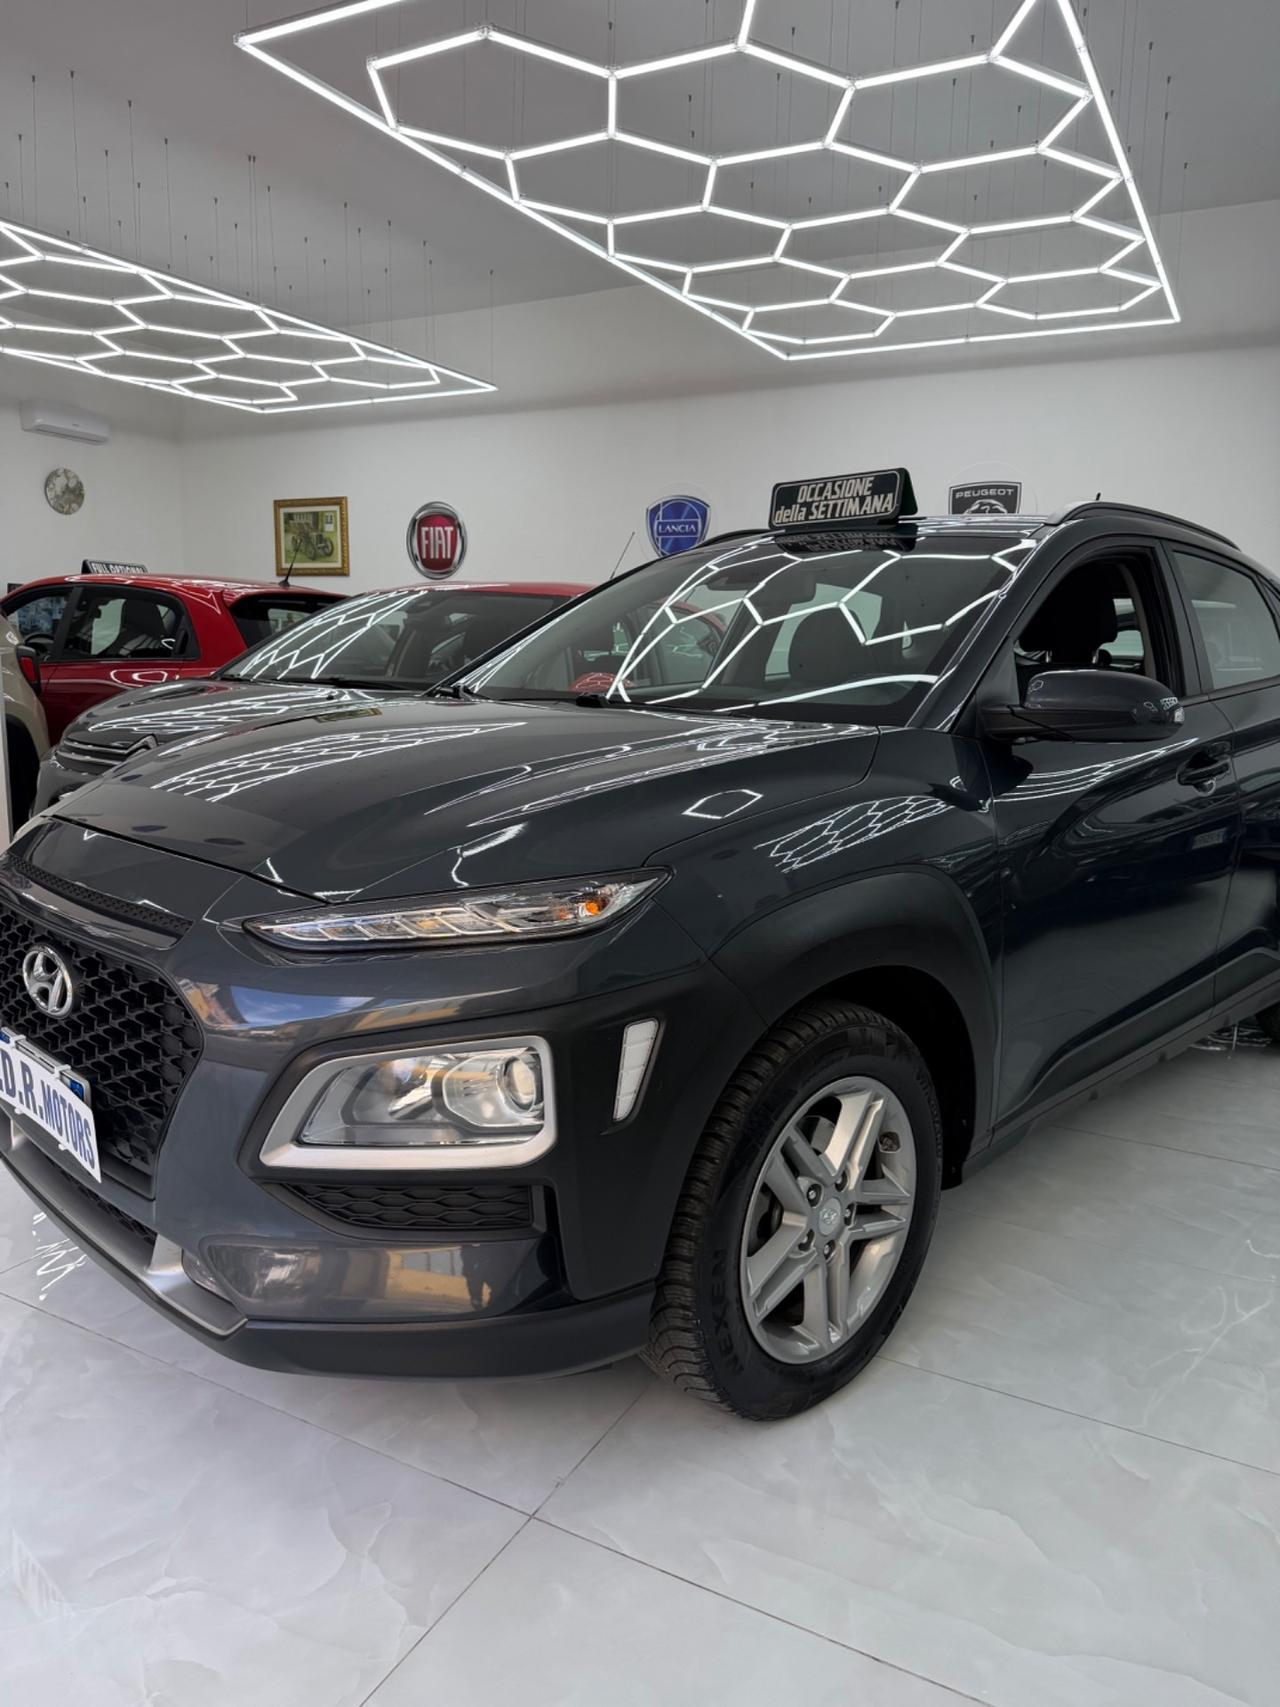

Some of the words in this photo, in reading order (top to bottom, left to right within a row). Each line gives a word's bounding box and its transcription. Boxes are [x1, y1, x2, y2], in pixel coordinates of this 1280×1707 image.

[797, 477, 875, 503] OCCASIONE
[955, 488, 1014, 499] PEUGEOT
[774, 506, 806, 524] della
[808, 493, 894, 520] SETTIMANA
[658, 524, 697, 533] LANCIA
[421, 526, 455, 560] FIAT
